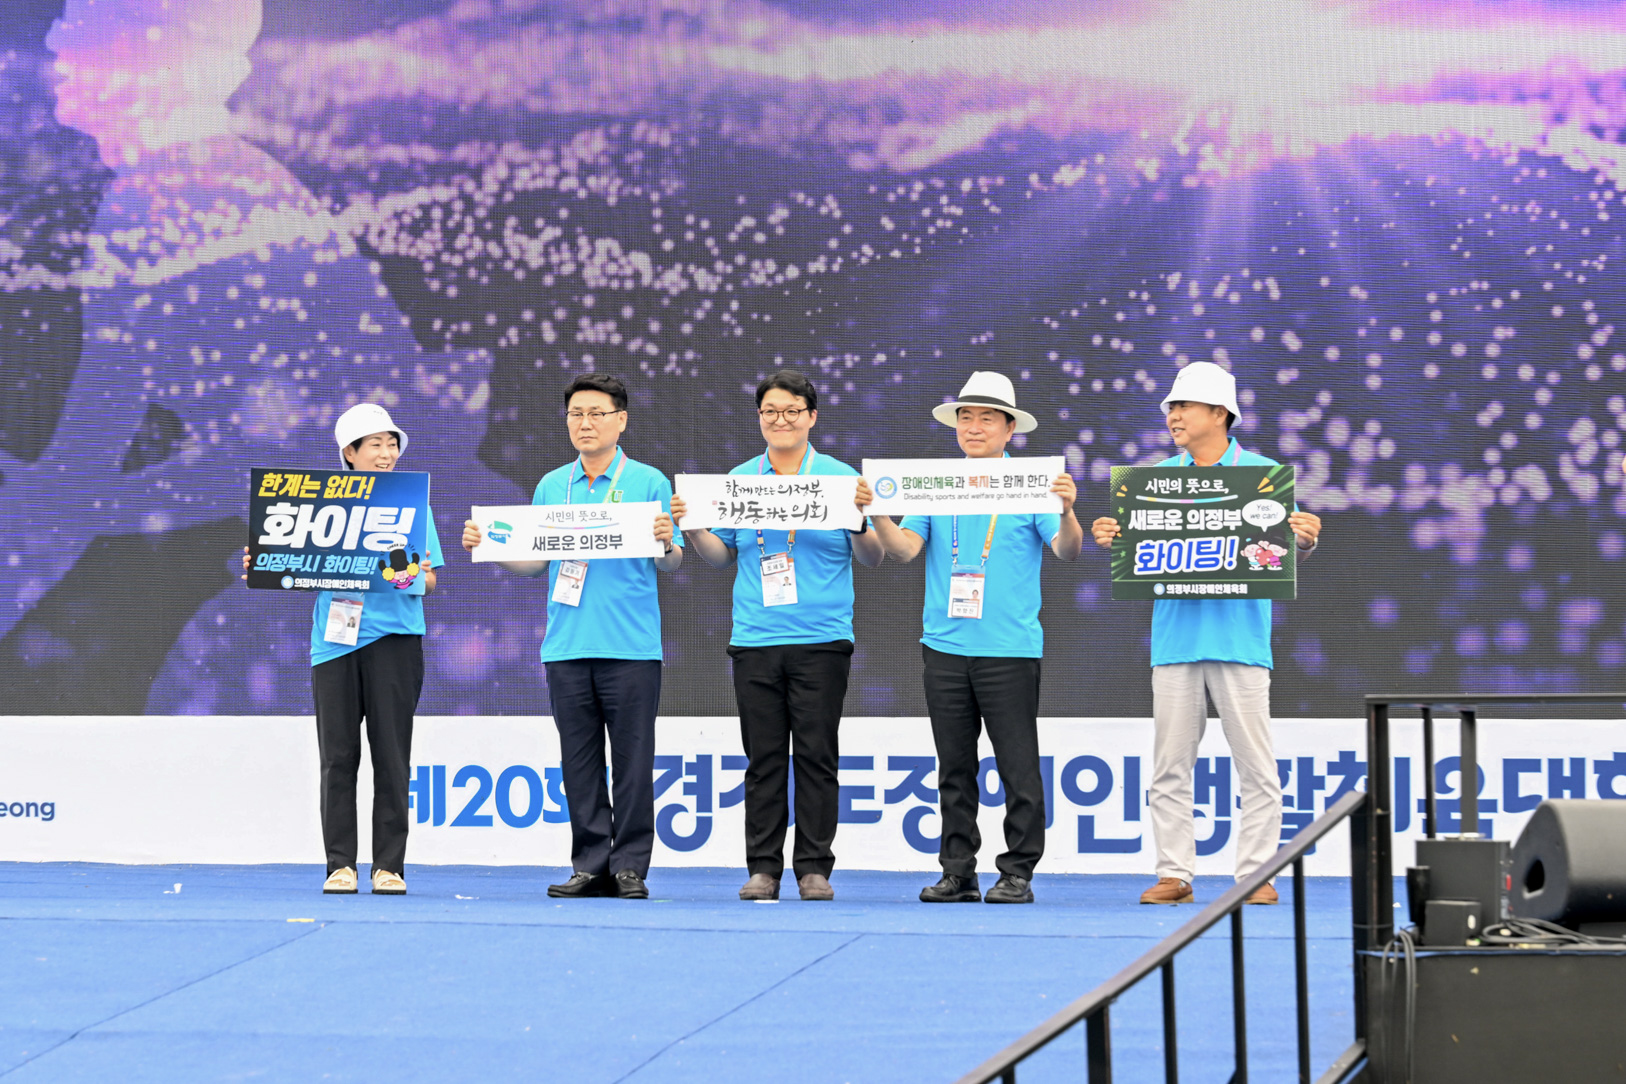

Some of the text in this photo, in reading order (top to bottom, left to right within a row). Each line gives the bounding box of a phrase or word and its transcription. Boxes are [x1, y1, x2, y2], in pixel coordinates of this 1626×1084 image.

[258, 473, 376, 500] 한계는 없다!
[725, 479, 753, 498] 함께
[755, 486, 775, 496] 만드는
[901, 474, 1051, 490] 장애인체육과 복지는 함께 한다.
[1145, 478, 1230, 494] 시민의 뜻으로,
[903, 492, 934, 501] Disability
[957, 492, 970, 500] and
[971, 492, 995, 500] welfare
[545, 510, 613, 523] 시민의 뜻으로,
[718, 500, 828, 525] 행동하는 의회
[1128, 509, 1243, 531] 새로운 의정부
[258, 502, 417, 552] 화이팅
[532, 534, 623, 552] 새로운 의정부
[253, 552, 379, 575] 의정부시 화이팅!
[1135, 537, 1238, 574] 화이팅!
[294, 577, 370, 590] 의정부시장애인체육회
[1166, 583, 1248, 595] 의정부시장애인체육회
